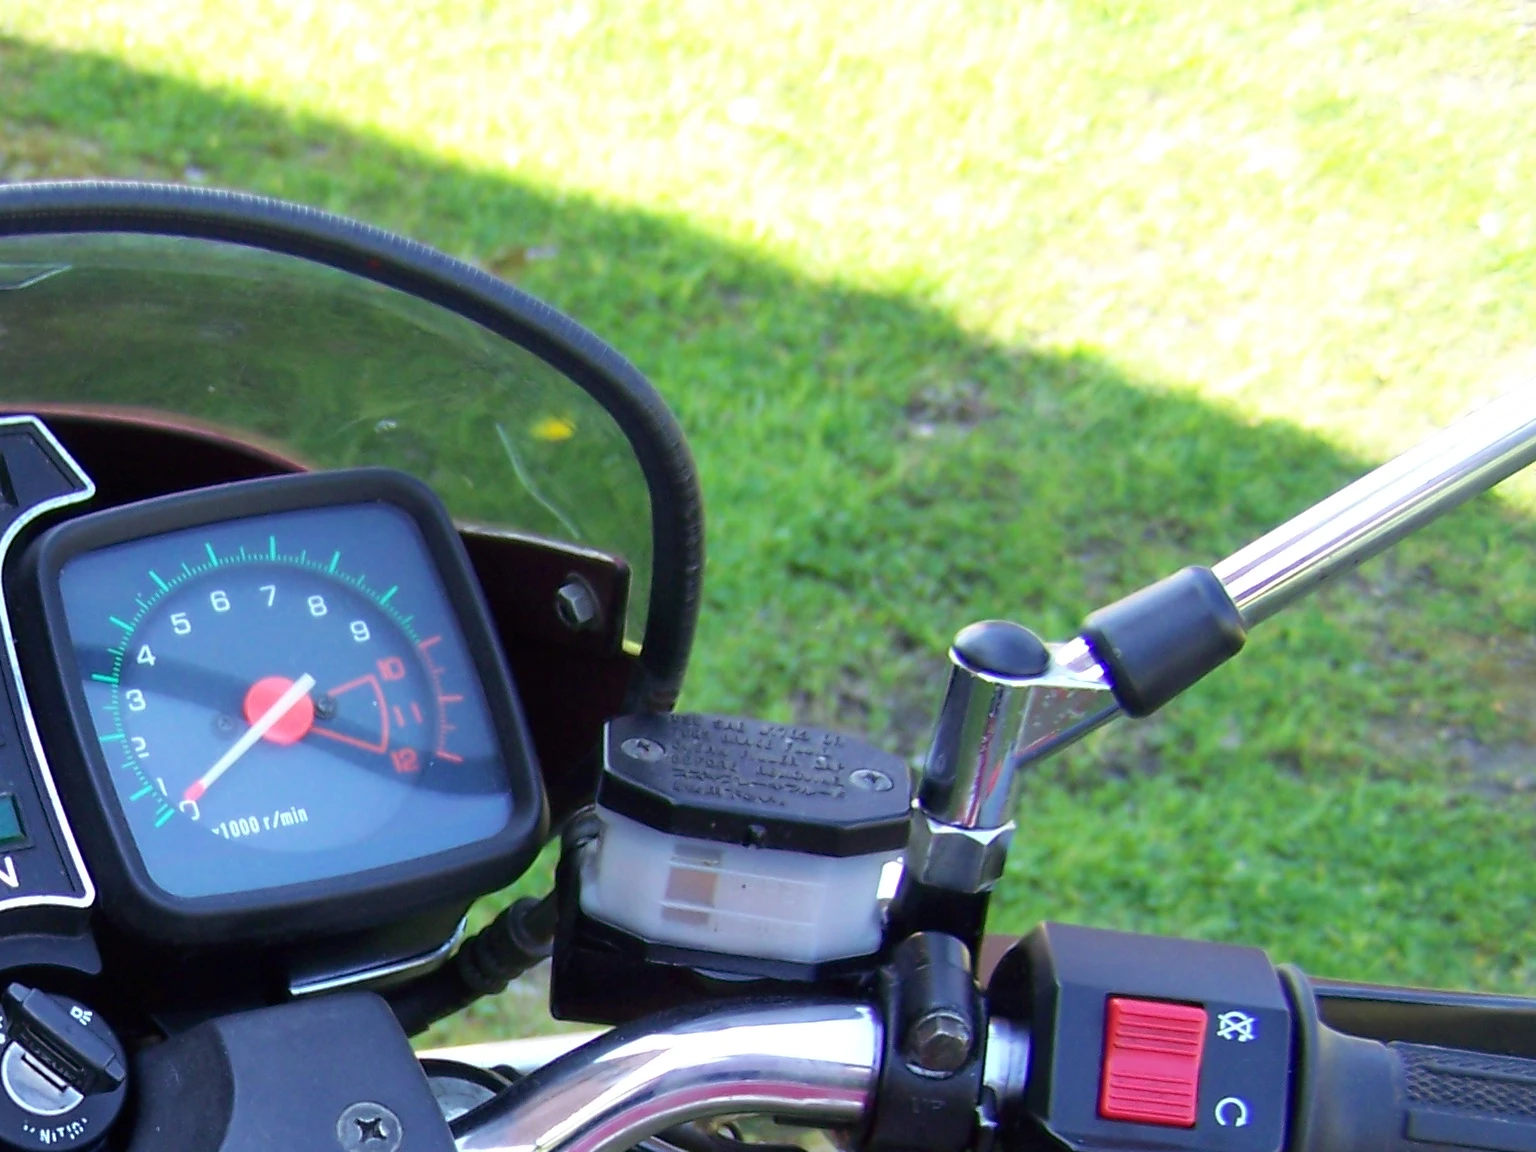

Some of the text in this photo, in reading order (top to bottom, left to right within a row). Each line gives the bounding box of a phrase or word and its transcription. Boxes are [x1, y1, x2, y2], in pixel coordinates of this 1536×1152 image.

[210, 590, 232, 613] 6
[259, 584, 277, 607] 7
[307, 595, 329, 618] 8
[170, 612, 192, 636] 5
[350, 620, 371, 644] 9
[136, 644, 157, 667] 4
[376, 656, 406, 682] 10
[126, 688, 147, 713] 3
[394, 703, 423, 728] 11
[130, 736, 150, 760] 2
[390, 748, 420, 774] 12
[262, 806, 309, 832] r/min
